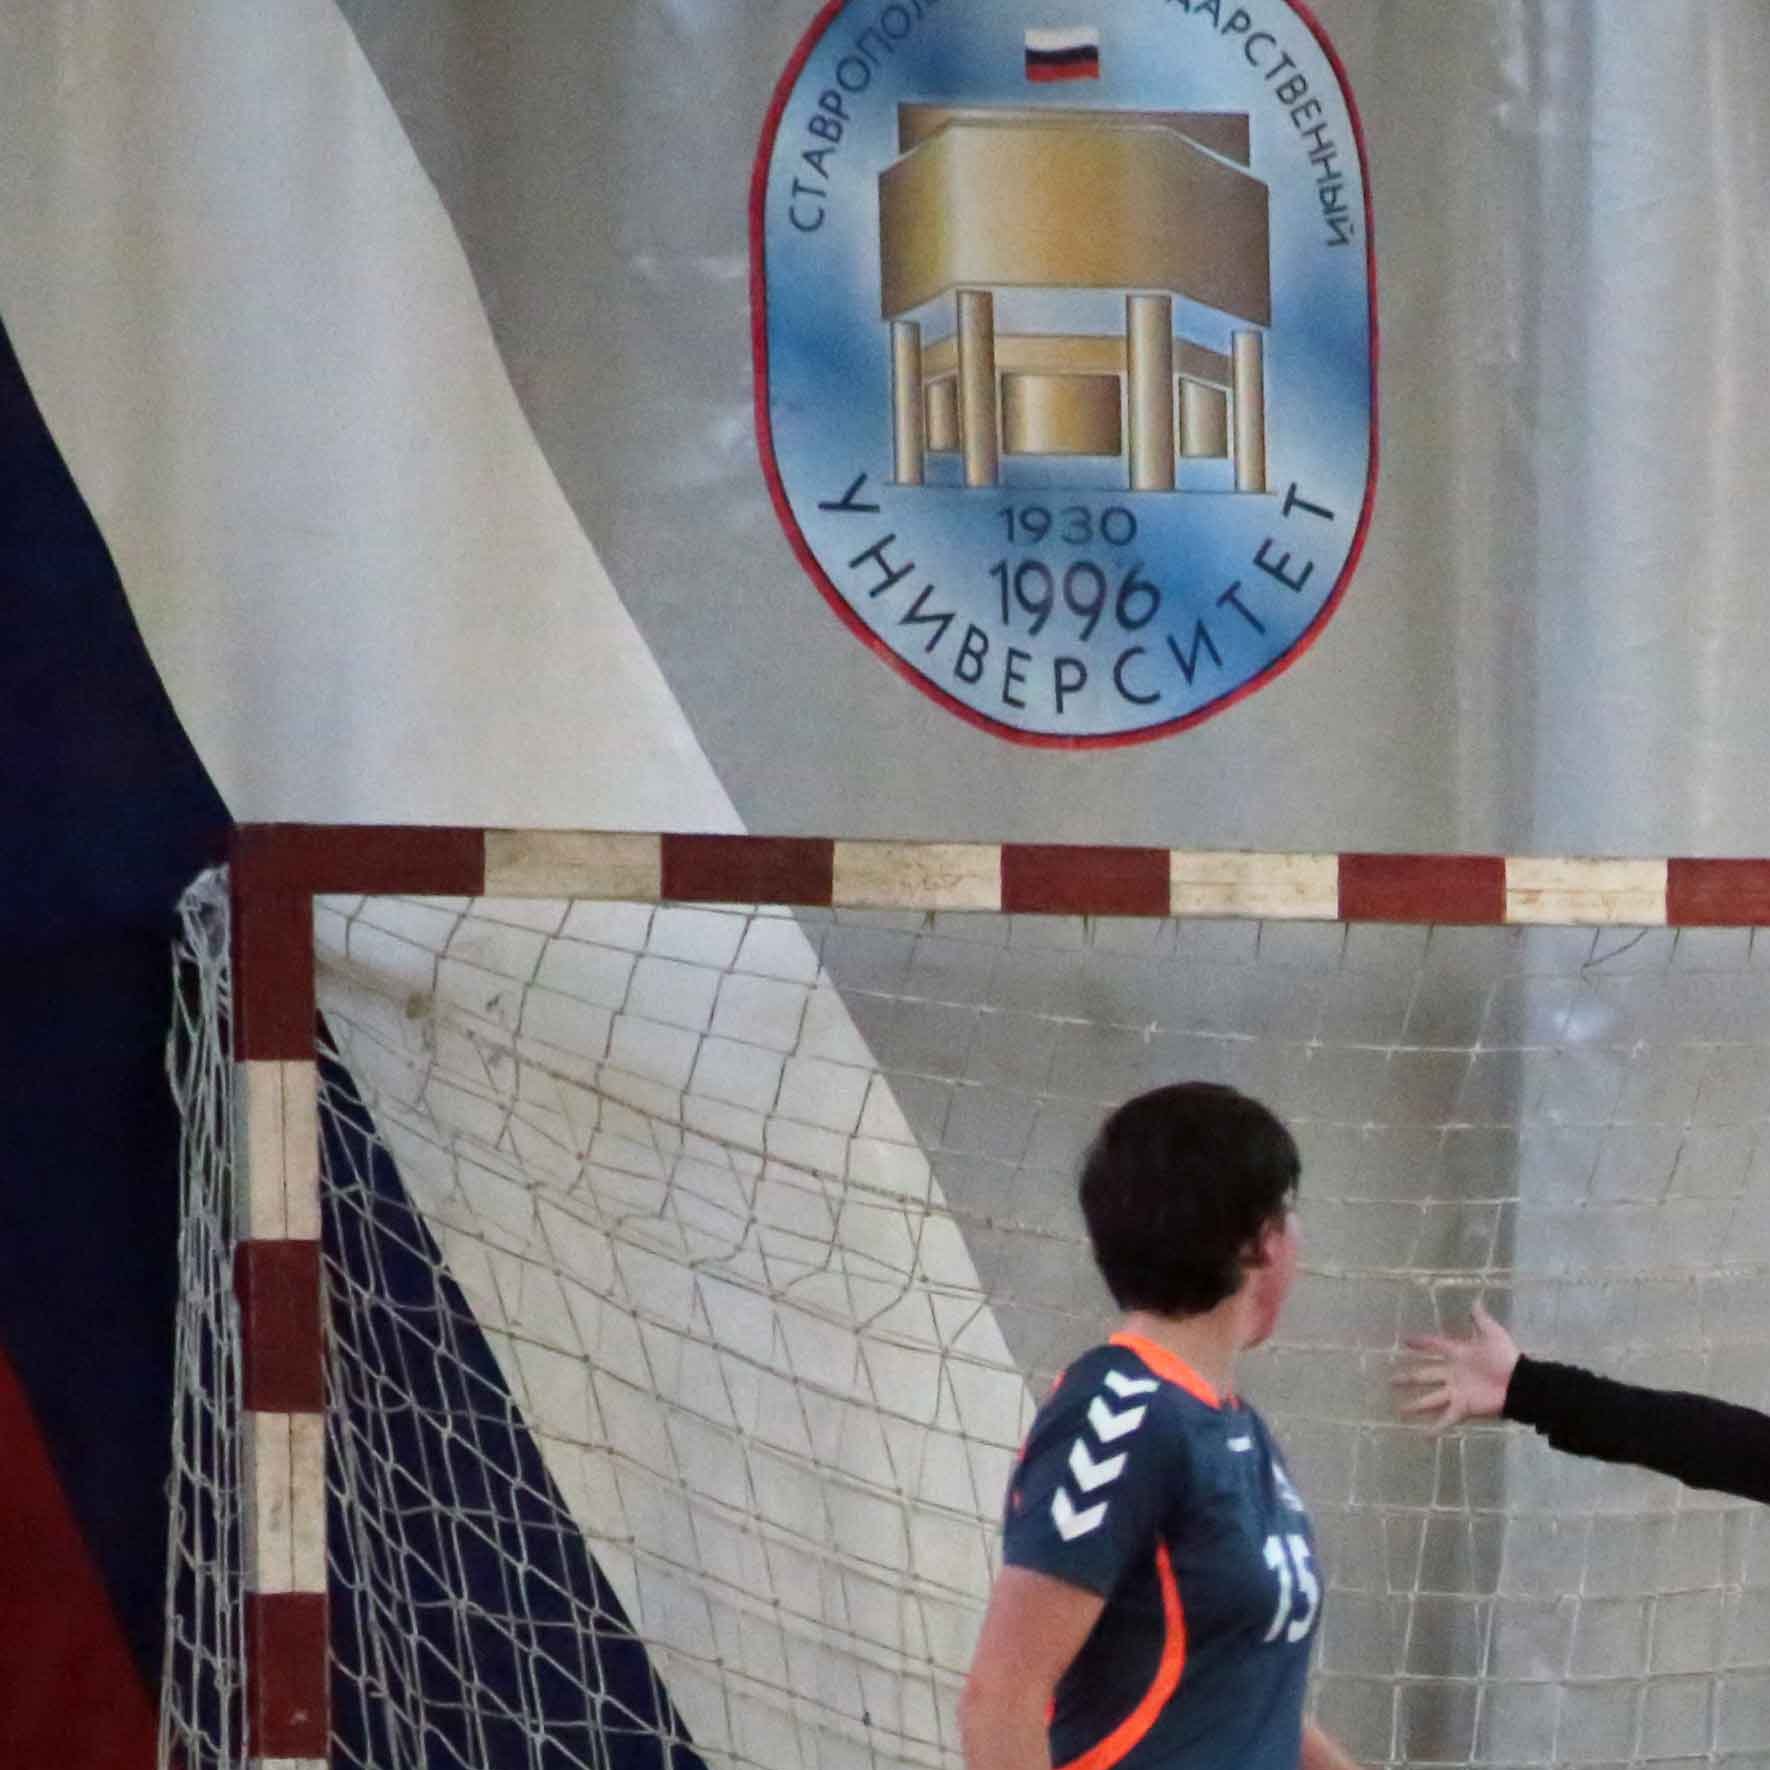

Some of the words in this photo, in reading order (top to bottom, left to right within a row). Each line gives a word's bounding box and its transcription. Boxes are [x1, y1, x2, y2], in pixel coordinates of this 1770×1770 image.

[1001, 507, 1137, 546] 1930
[818, 473, 1335, 714] УНИВЕРСИТЕТ
[990, 560, 1161, 642] 1996
[1262, 1534, 1320, 1643] 15
